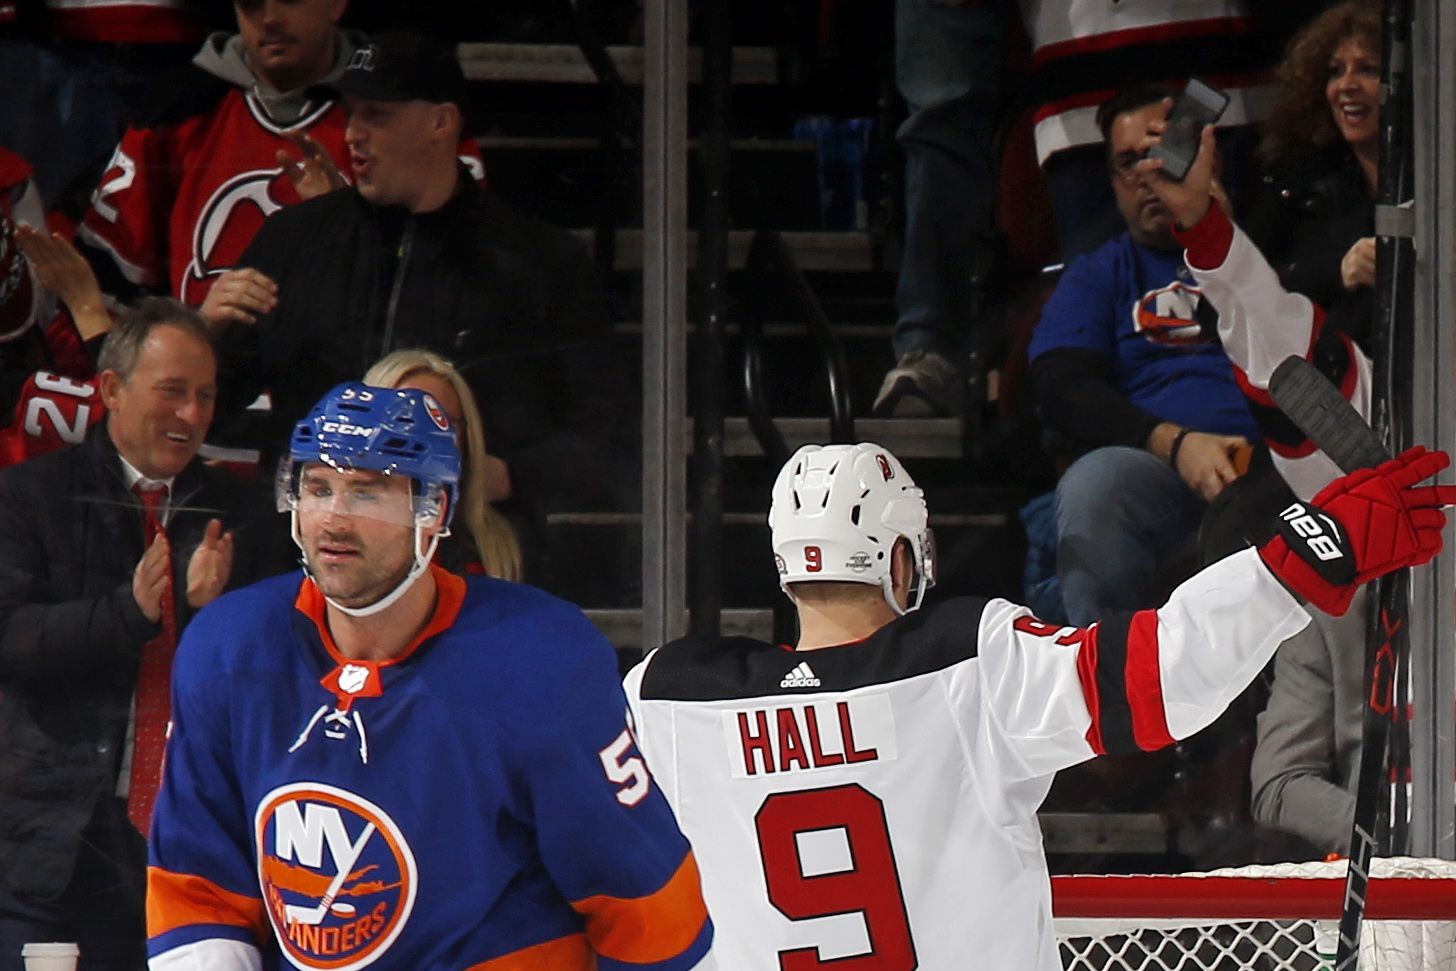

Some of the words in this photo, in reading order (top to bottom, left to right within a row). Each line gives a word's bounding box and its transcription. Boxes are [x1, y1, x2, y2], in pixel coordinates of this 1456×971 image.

[321, 421, 374, 438] CCM
[804, 545, 823, 573] 9
[780, 677, 821, 688] adidas
[736, 701, 878, 775] HALL
[275, 799, 378, 926] NY
